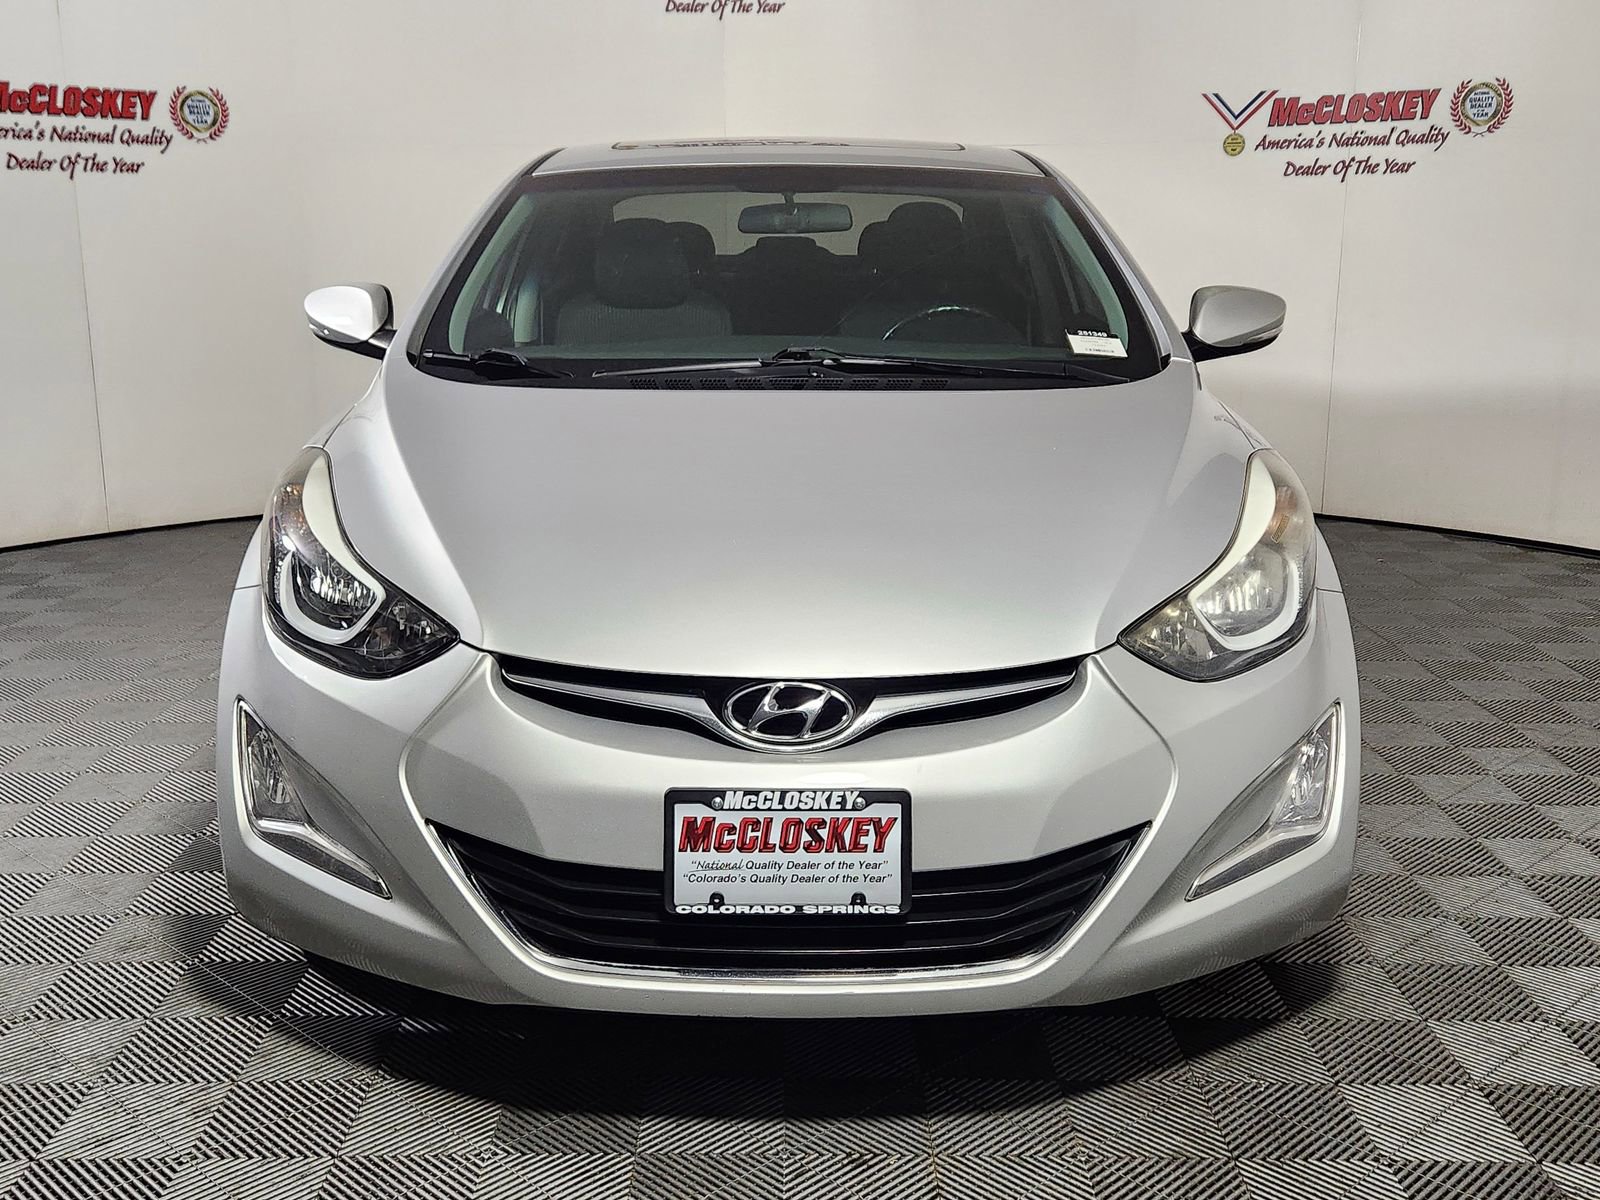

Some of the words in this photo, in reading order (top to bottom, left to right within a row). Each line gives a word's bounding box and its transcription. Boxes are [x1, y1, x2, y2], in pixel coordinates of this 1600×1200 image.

[665, 0, 708, 13] Dealer
[711, 0, 728, 21] Of
[729, 0, 753, 13] The
[756, 0, 785, 14] Year
[1268, 88, 1442, 127] McCLOSKEY
[50, 124, 117, 144] National
[120, 127, 173, 155] Quality
[1254, 130, 1326, 152] America's
[1328, 126, 1393, 148] National
[1395, 125, 1450, 152] Quality
[6, 151, 57, 172] Dealer
[59, 151, 81, 180] Of
[80, 153, 108, 174] The
[112, 156, 145, 175] Year
[1283, 157, 1331, 177] Dealer
[1333, 156, 1356, 183] Of
[1355, 156, 1382, 174] The
[1384, 157, 1416, 174] Year
[723, 791, 859, 810] McCLOSKEY
[678, 816, 898, 853] McCLOSKEY
[691, 858, 744, 872] "National
[745, 860, 783, 872] Quality
[786, 860, 820, 870] Dealer
[823, 860, 836, 870] of
[838, 860, 855, 870] the
[858, 860, 889, 870] Year"
[683, 873, 747, 884] "Colorado's
[749, 874, 788, 886] Quality
[790, 874, 825, 884] Dealer
[828, 873, 841, 884] of
[842, 874, 859, 884] the
[862, 874, 893, 884] Year"
[675, 904, 796, 915] COLORADO
[802, 904, 900, 915] SPRINGS
